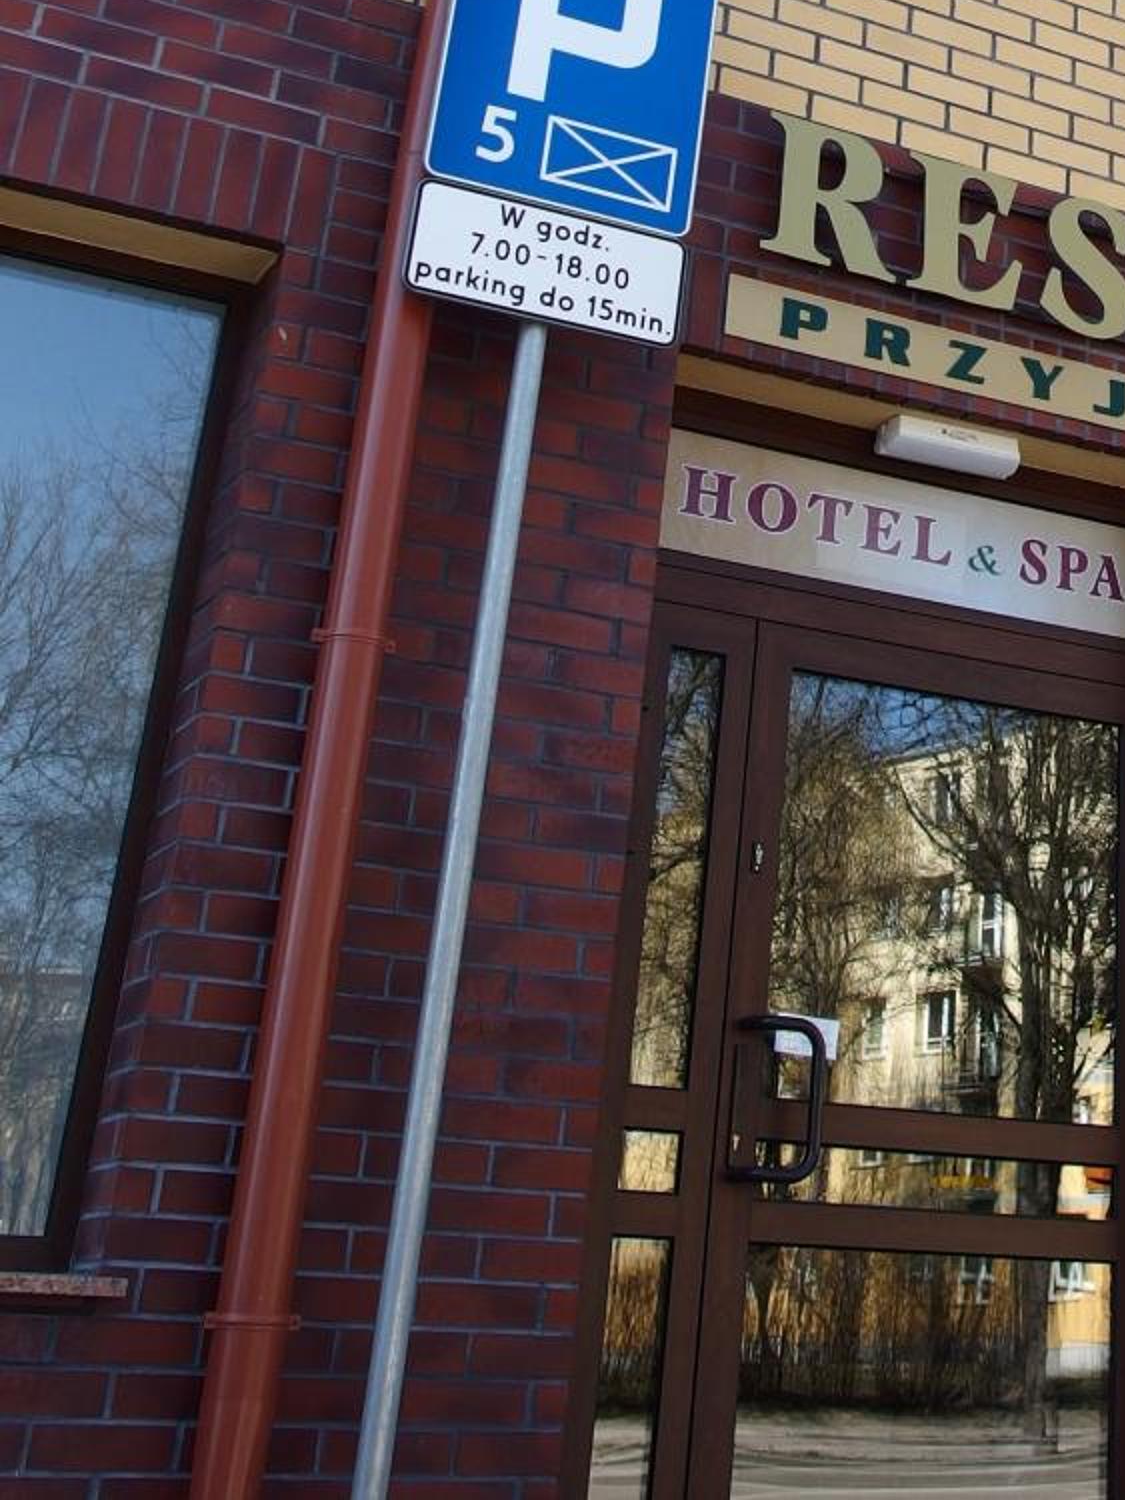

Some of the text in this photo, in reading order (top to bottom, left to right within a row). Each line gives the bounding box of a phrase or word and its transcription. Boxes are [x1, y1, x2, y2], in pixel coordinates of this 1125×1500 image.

[474, 104, 518, 164] 5
[500, 204, 611, 252] W godz.
[413, 260, 672, 337] parking do 15min.
[679, 465, 952, 567] HOTEL
[968, 544, 1002, 577] &
